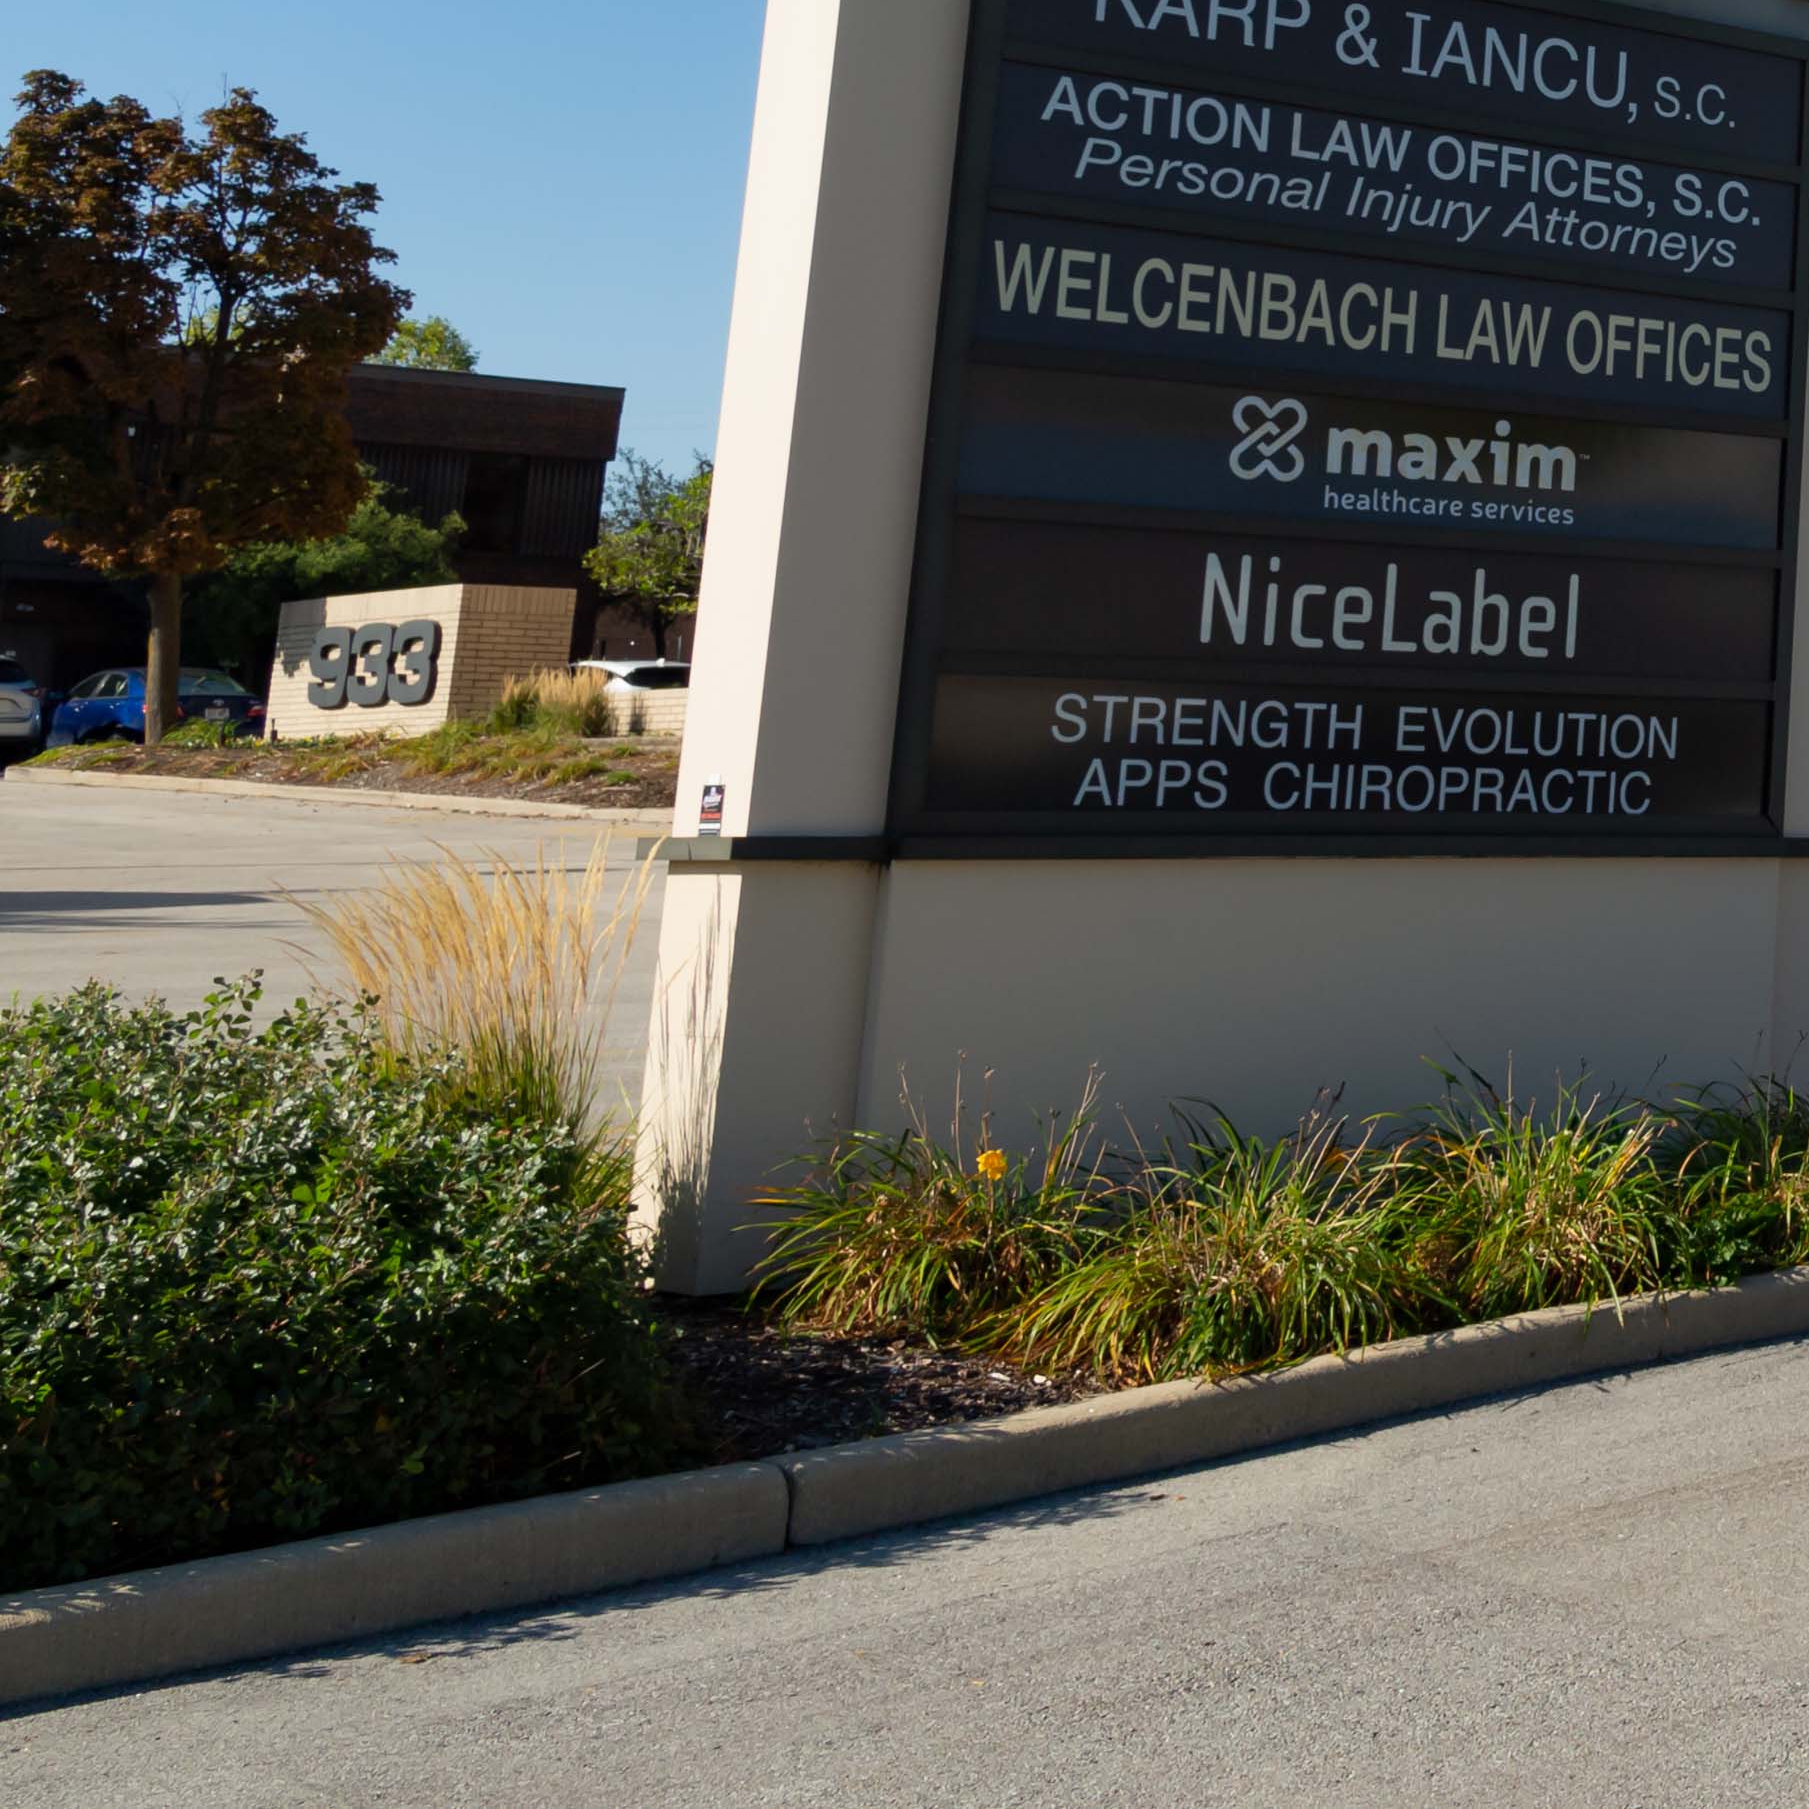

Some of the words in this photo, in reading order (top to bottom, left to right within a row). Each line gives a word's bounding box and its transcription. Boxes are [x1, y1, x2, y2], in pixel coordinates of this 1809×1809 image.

[1336, 3, 1379, 67] &
[1402, 12, 1637, 123] IANCU,
[1655, 77, 1735, 127] S.C.
[1041, 76, 1270, 152] ACTION
[1291, 112, 1411, 171] LAW
[1428, 136, 1655, 217] OFFICES,
[1673, 174, 1760, 225] S.C.
[1075, 138, 1331, 210] Personal
[1346, 177, 1491, 242] Injury
[1502, 202, 1736, 272] Attorneys
[995, 240, 1417, 354] WELCENBACH
[1437, 294, 1551, 367] LAW
[1567, 310, 1771, 392] OFFICES
[1324, 484, 1463, 516] healthcare
[1472, 502, 1573, 524] services
[1326, 420, 1576, 491] maxim
[1200, 553, 1579, 658] NiceLabel
[308, 619, 442, 710] 933
[1051, 693, 1362, 749] STRENGTH
[1397, 706, 1677, 759] EVOLUTION
[1074, 758, 1227, 808] APPS
[1264, 762, 1651, 814] CHIROPRACTIC
